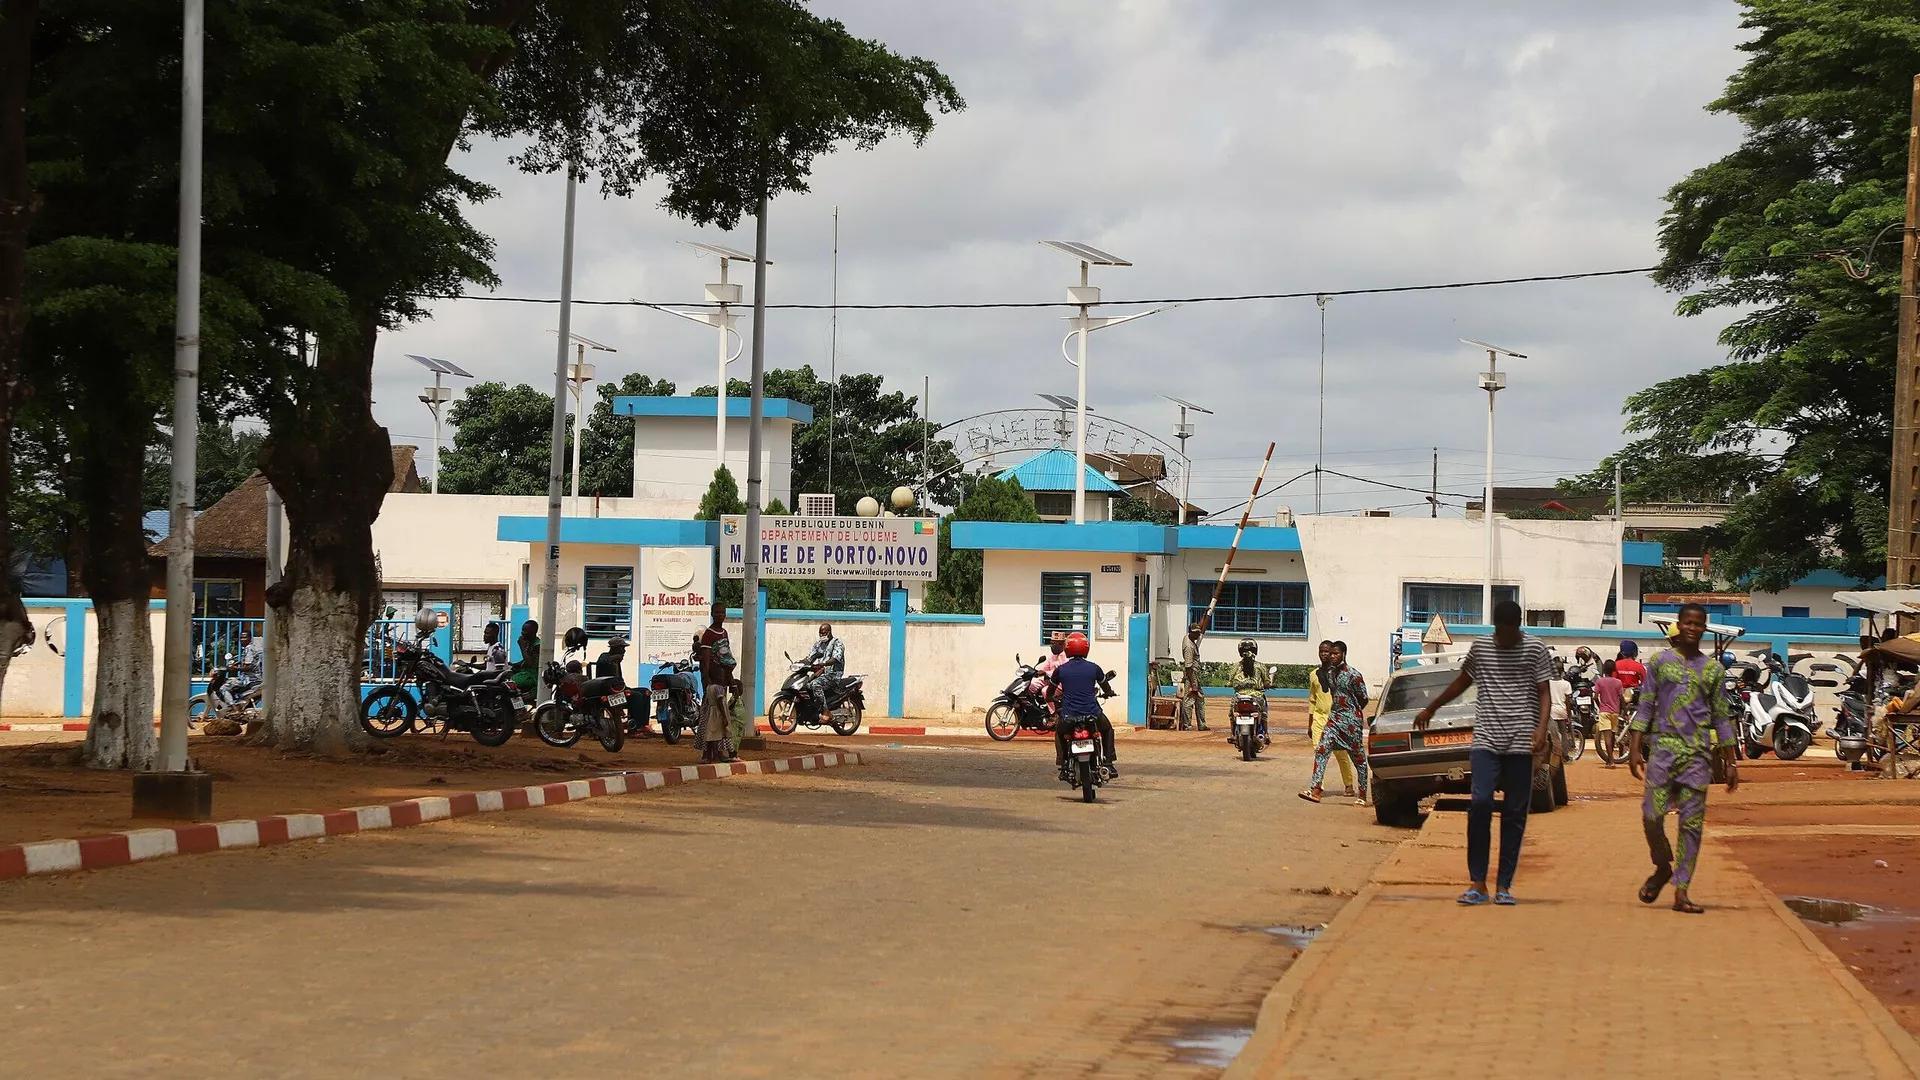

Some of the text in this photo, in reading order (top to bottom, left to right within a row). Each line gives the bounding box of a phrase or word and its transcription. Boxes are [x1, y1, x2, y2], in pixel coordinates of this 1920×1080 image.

[775, 520, 885, 529] REPUBLIQUE DU BENIN
[761, 530, 898, 542] DEPARTEMENT DE L'OUEME
[730, 544, 928, 565] MRIE DE PORTO-NOVO
